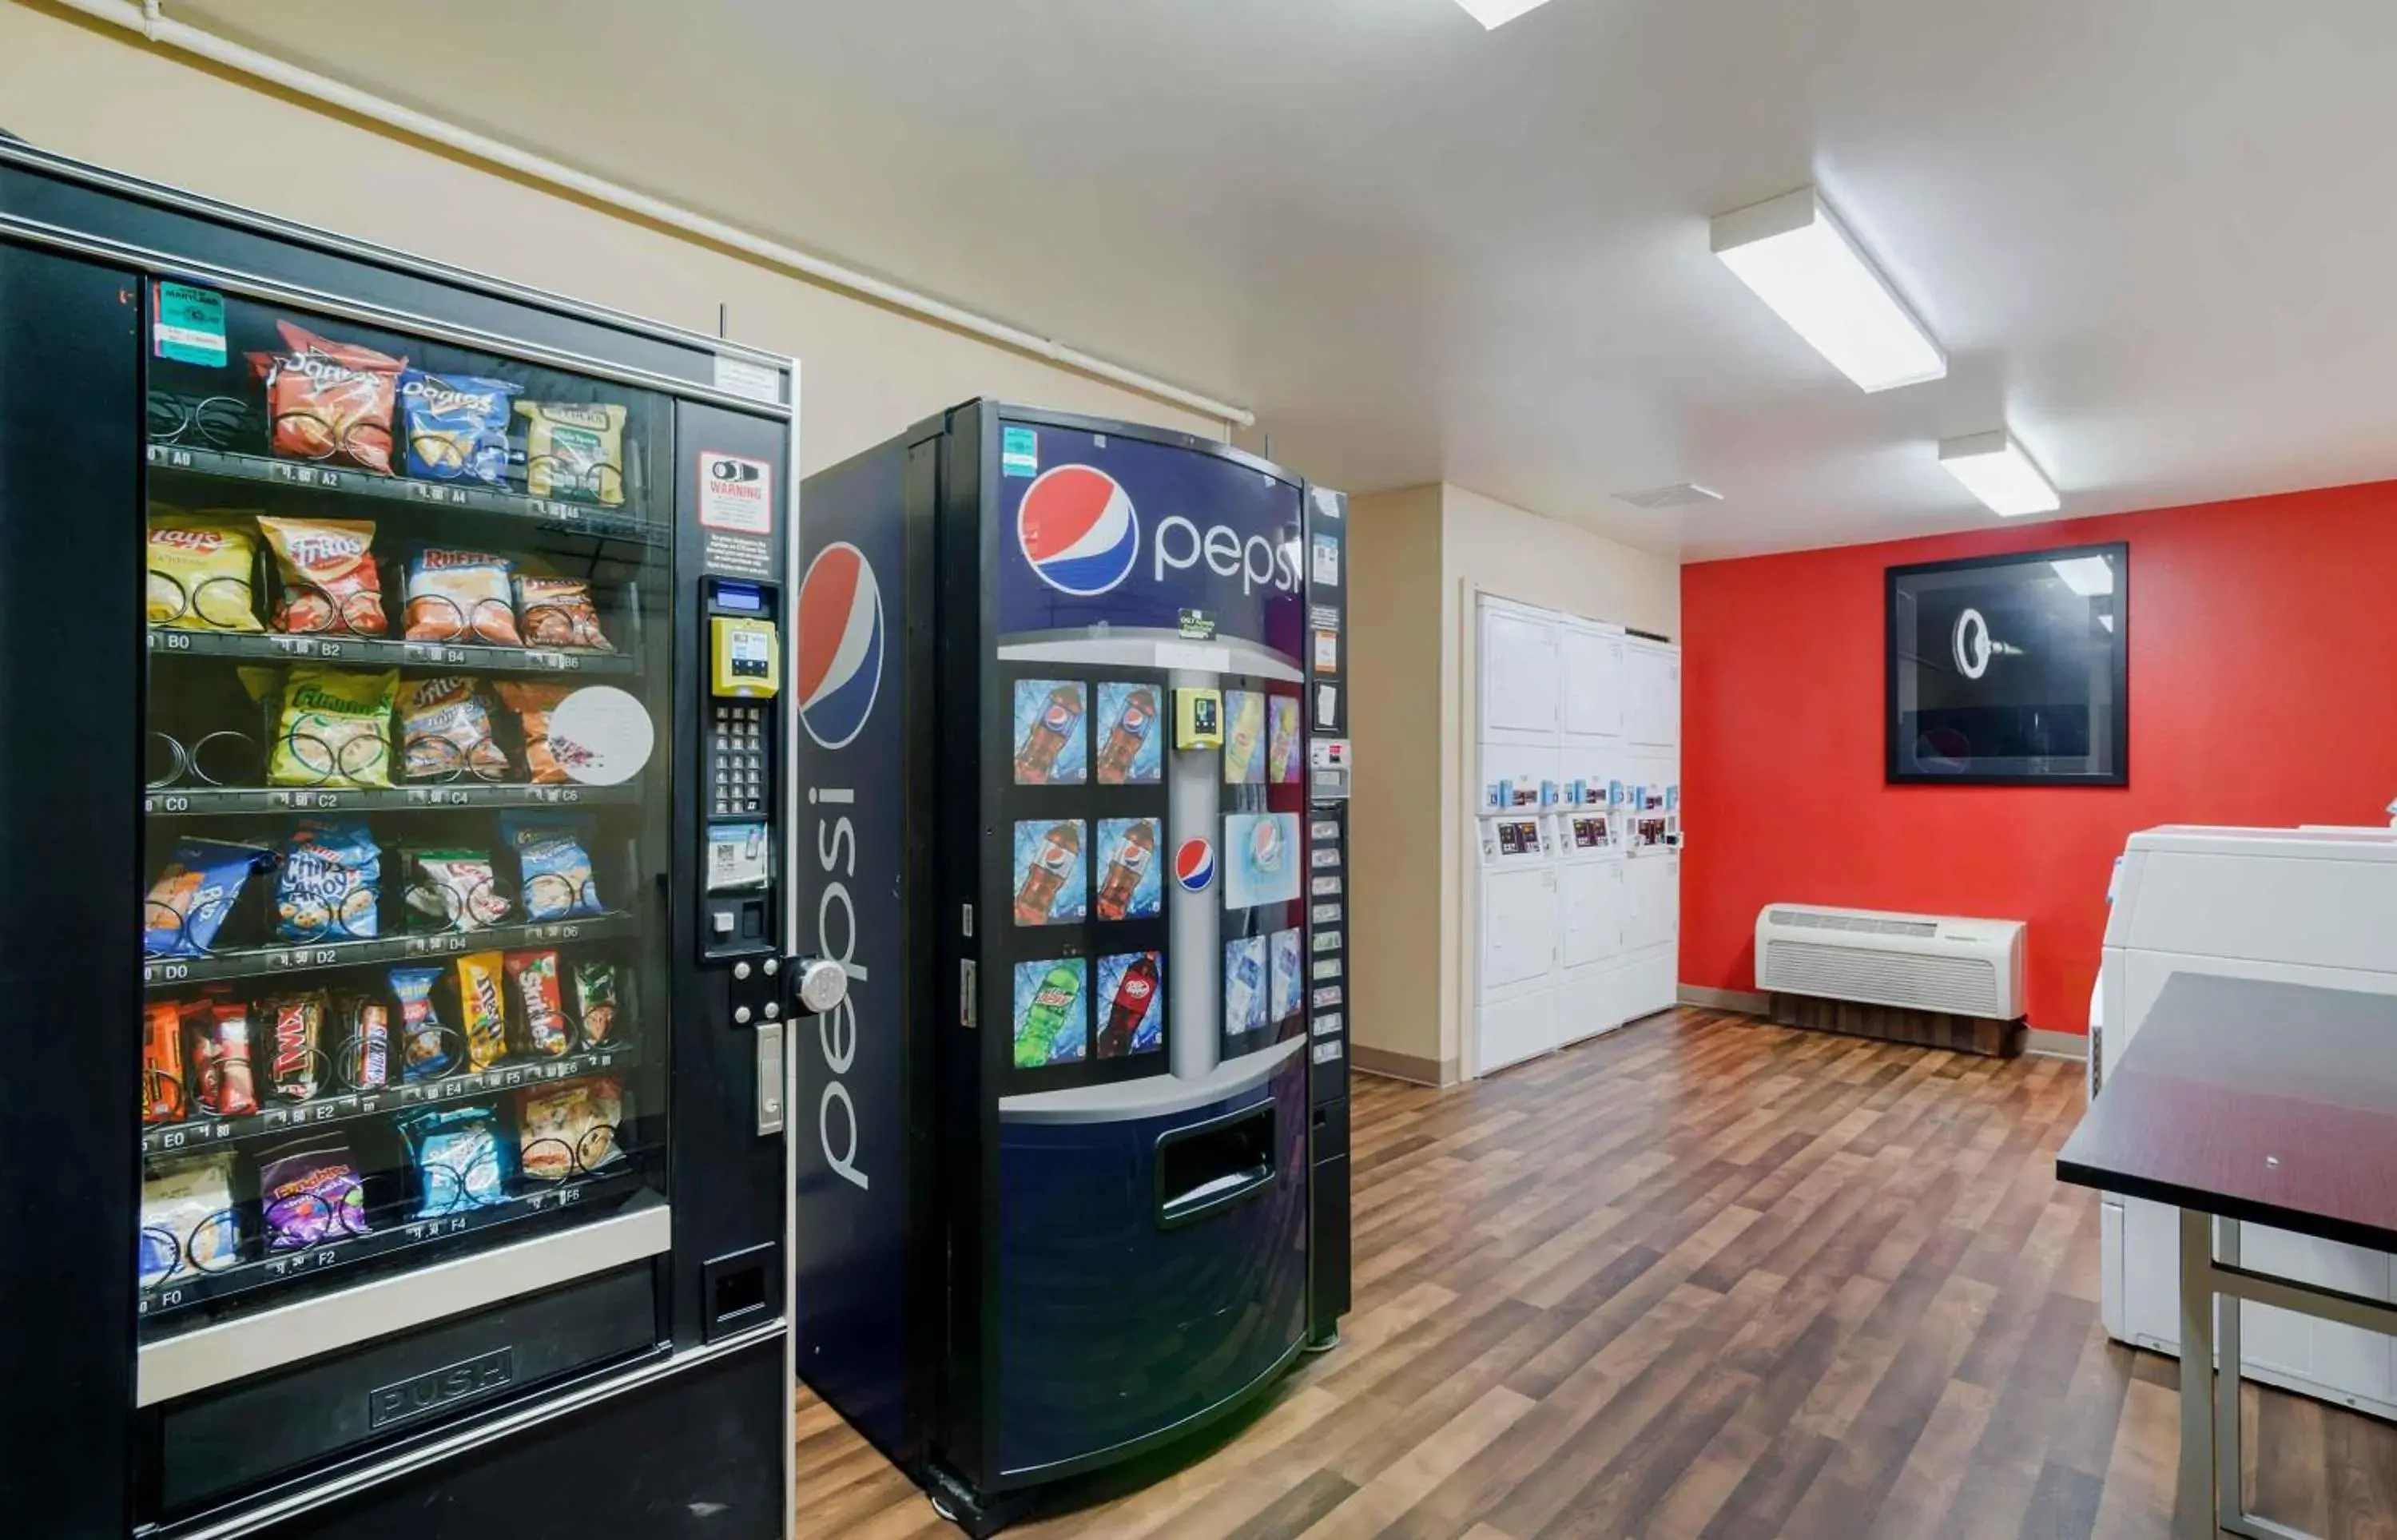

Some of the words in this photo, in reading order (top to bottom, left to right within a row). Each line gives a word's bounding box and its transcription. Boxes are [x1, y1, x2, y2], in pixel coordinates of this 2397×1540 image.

[403, 380, 497, 413] Doritos
[173, 451, 190, 466] A0
[322, 473, 337, 486] A2
[452, 489, 466, 502] A4
[710, 480, 762, 500] WARNING
[152, 529, 221, 550] Lay's
[169, 635, 189, 649] B0
[321, 641, 340, 656] B2
[447, 650, 465, 663] B4
[165, 797, 188, 811] C0
[319, 794, 337, 808] C2
[451, 792, 468, 804] C4
[449, 939, 467, 951] D4
[316, 950, 336, 963] D2
[165, 965, 188, 979] D0
[808, 787, 869, 1191] pepsi
[519, 970, 550, 1050] Skittles
[446, 1083, 461, 1095] E4
[317, 1105, 334, 1118] E2
[164, 1133, 185, 1148] E0
[451, 1218, 466, 1231] F4
[319, 1252, 335, 1265] F2
[162, 1290, 181, 1306] F0
